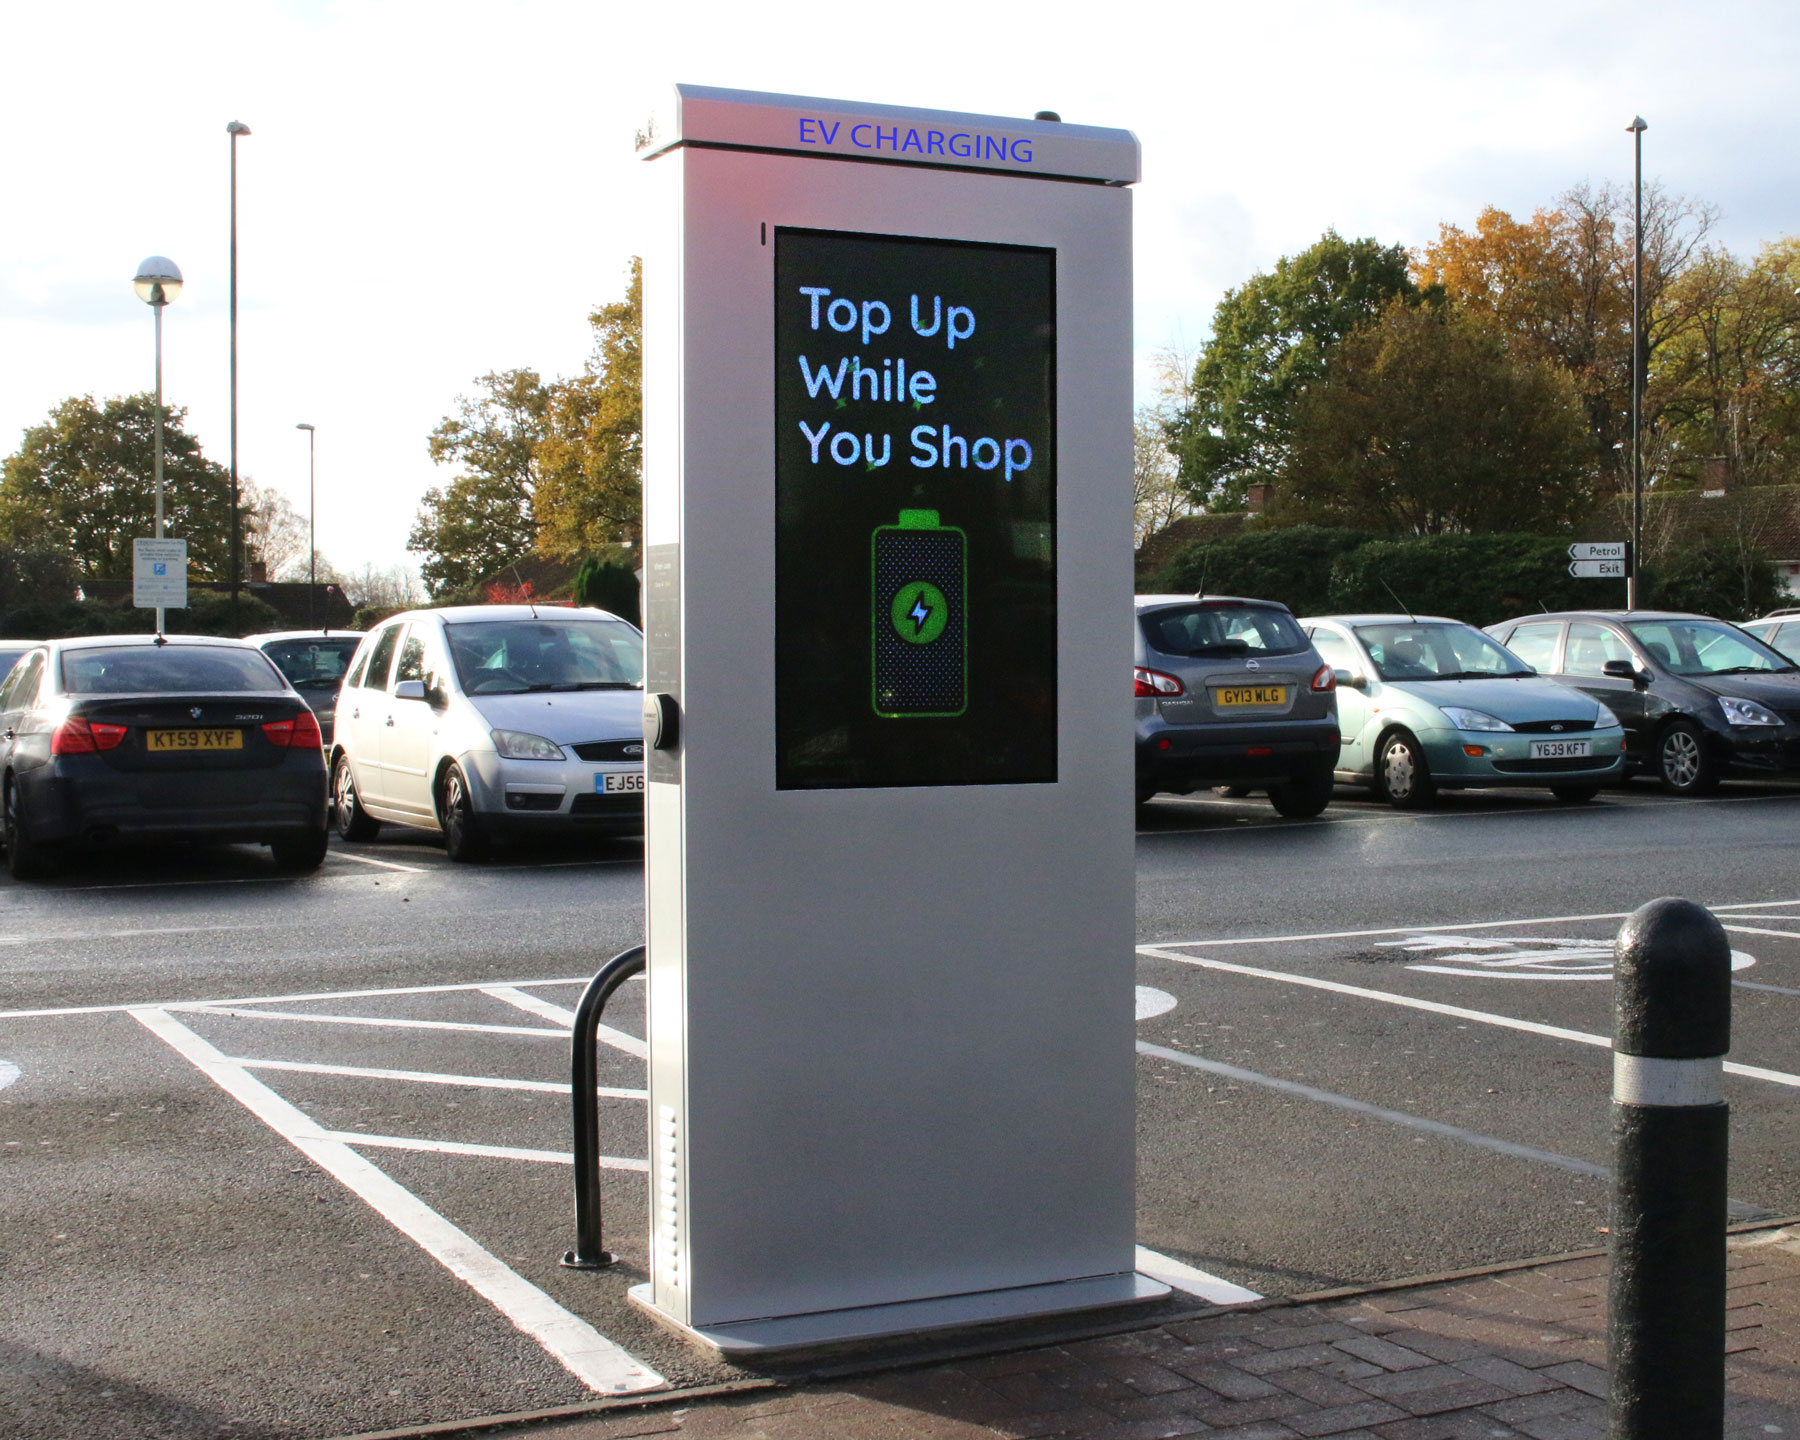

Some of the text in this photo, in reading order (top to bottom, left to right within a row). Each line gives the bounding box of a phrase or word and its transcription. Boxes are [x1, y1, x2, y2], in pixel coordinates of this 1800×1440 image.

[799, 118, 1033, 163] EV CHARGING
[799, 286, 976, 350] Top Up
[799, 355, 938, 405] While
[799, 421, 1033, 483] You Shop
[1589, 546, 1621, 556] Petrol
[1599, 563, 1620, 574] Exit
[1224, 688, 1279, 704] GY13 WLG
[153, 730, 235, 748] KT59 XYF
[1536, 742, 1586, 757] Y639 KFT
[605, 775, 645, 791] EJ56
